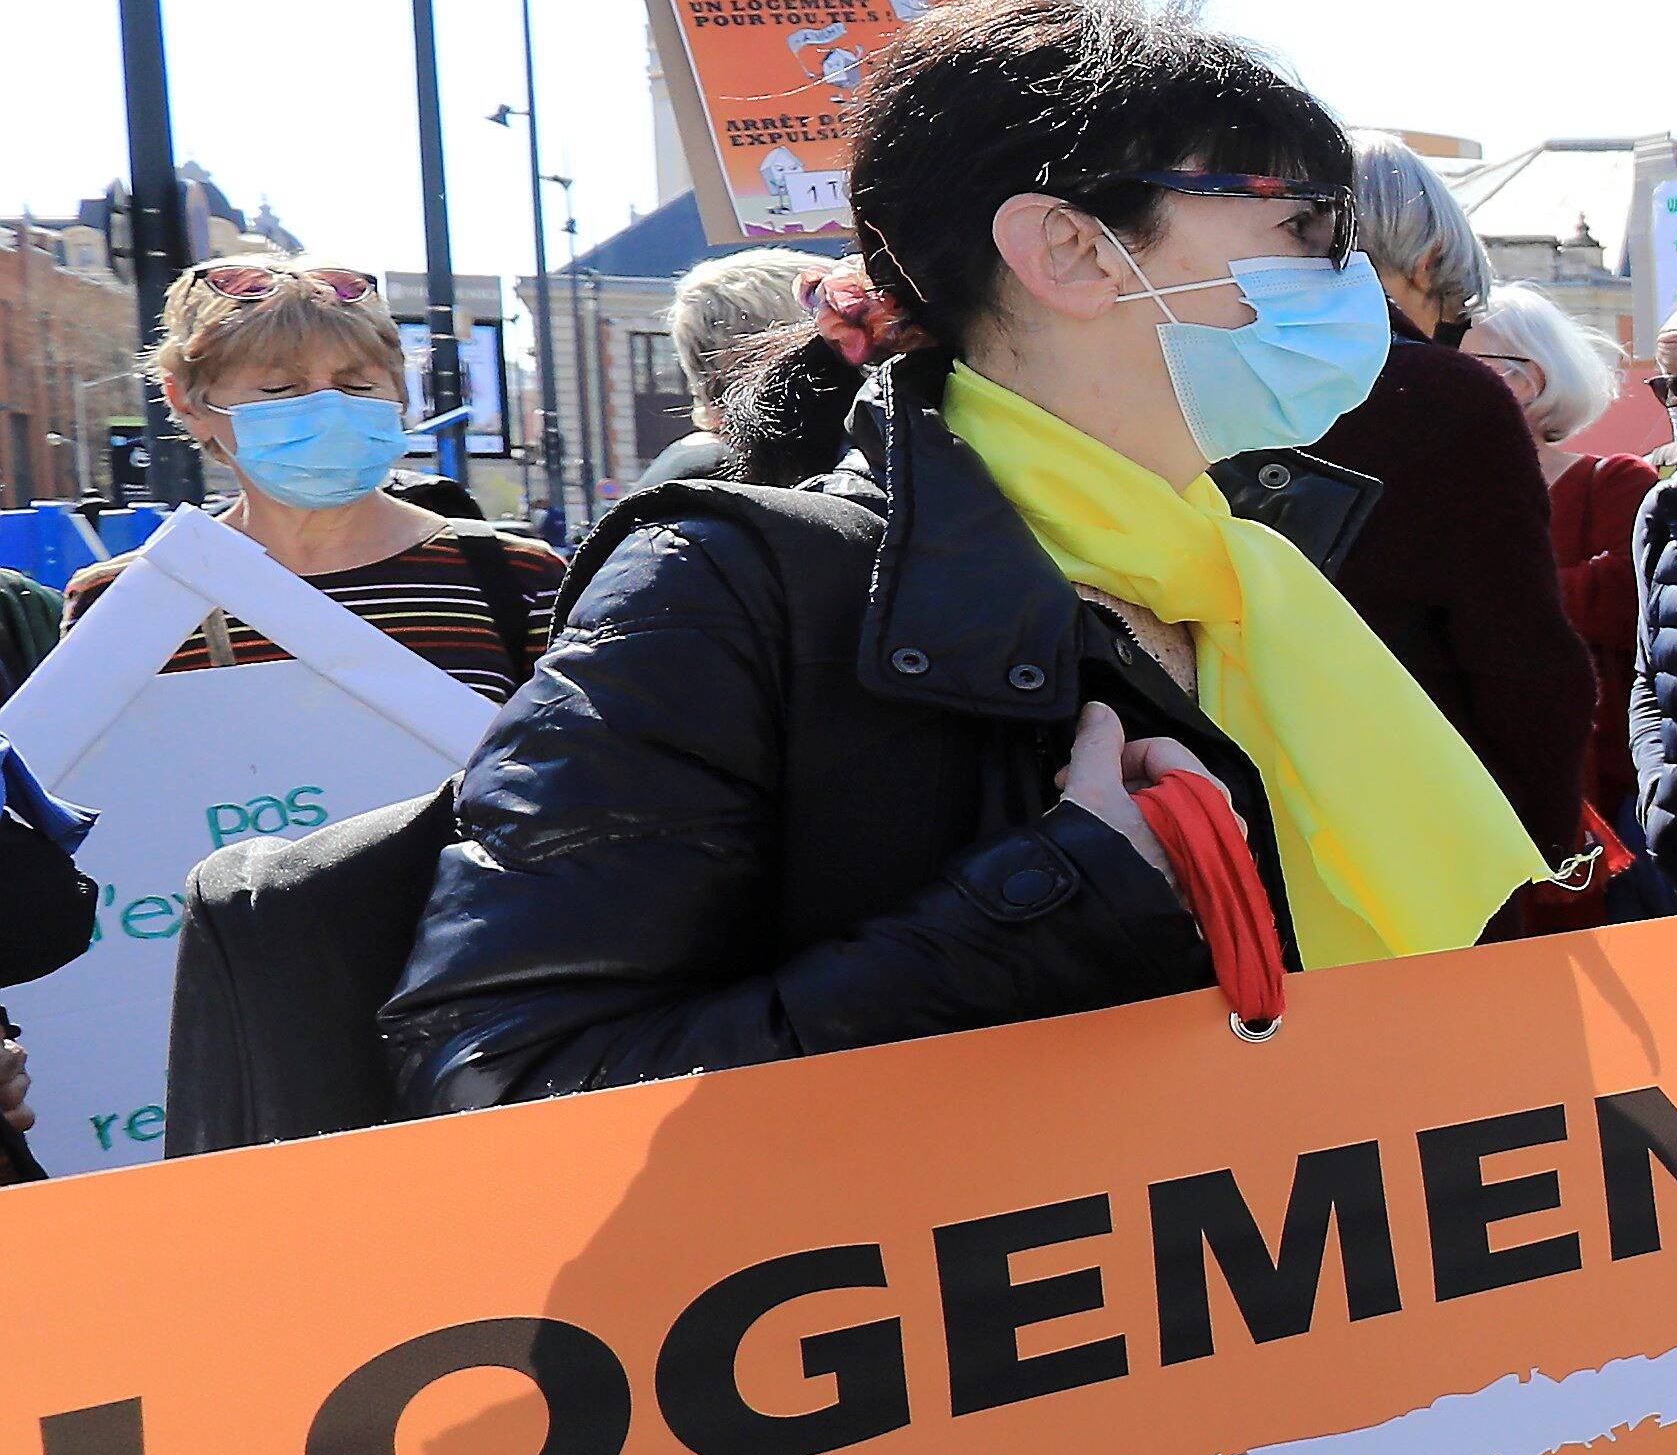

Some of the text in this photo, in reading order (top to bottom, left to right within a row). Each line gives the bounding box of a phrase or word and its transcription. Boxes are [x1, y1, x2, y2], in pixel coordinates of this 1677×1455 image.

[690, 1, 722, 12] UN
[695, 11, 765, 27] POUR
[206, 785, 328, 850] pas
